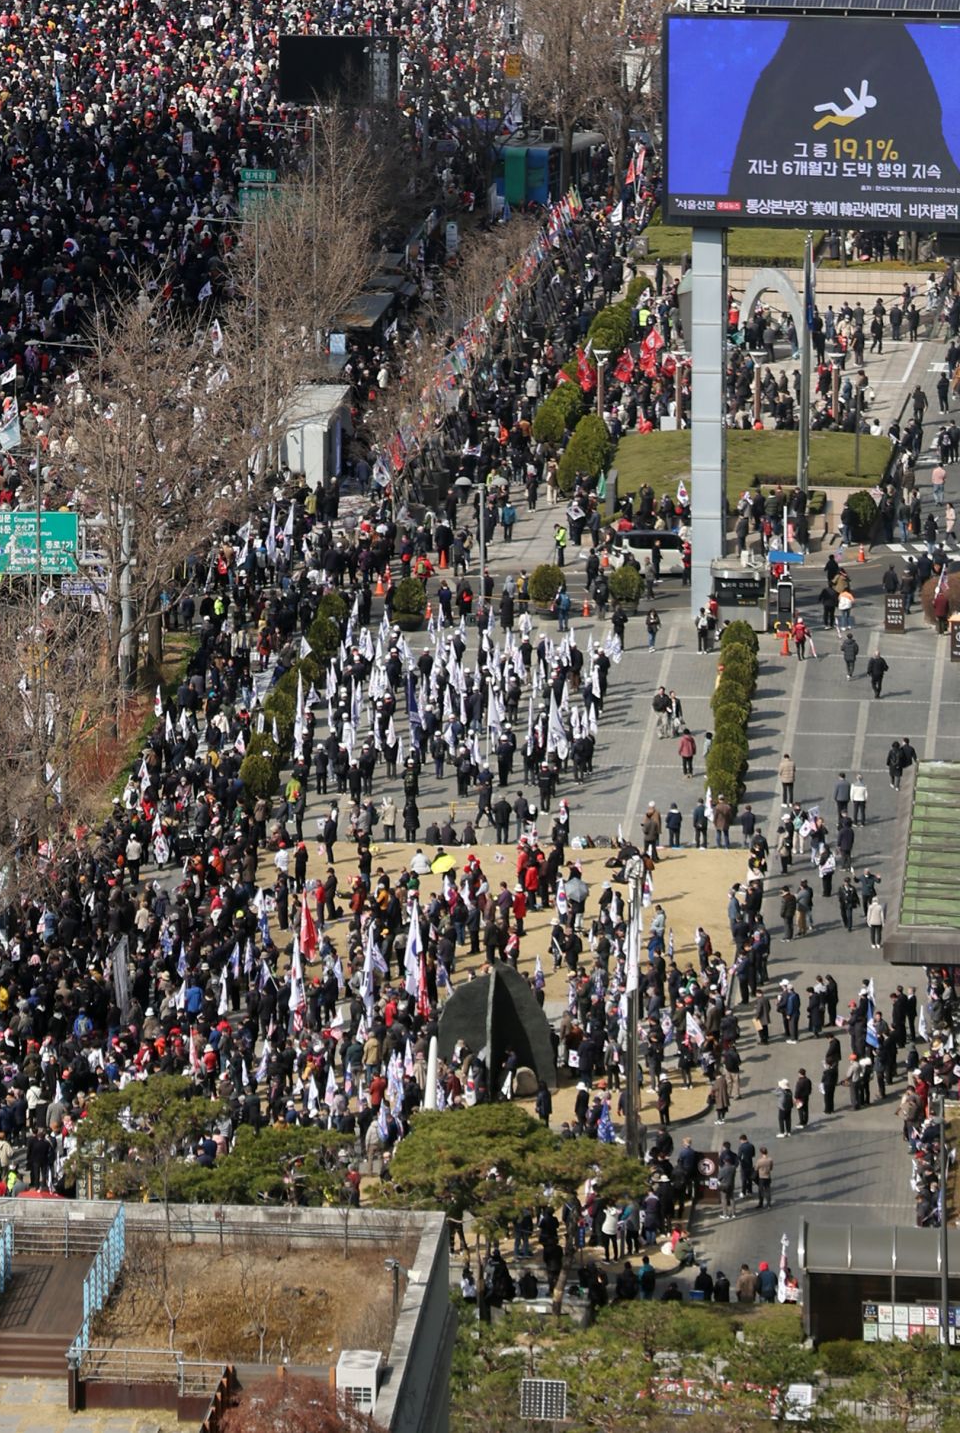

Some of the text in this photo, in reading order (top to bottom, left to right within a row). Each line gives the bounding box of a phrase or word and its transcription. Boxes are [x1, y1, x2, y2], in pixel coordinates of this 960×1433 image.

[794, 138, 899, 161] 그 중 19.1%
[748, 159, 941, 180] 지난 6개월간 도박 행위 지속
[677, 199, 716, 211] 서울신문
[745, 199, 808, 215] 통상본부장
[909, 204, 958, 220] 비차별적
